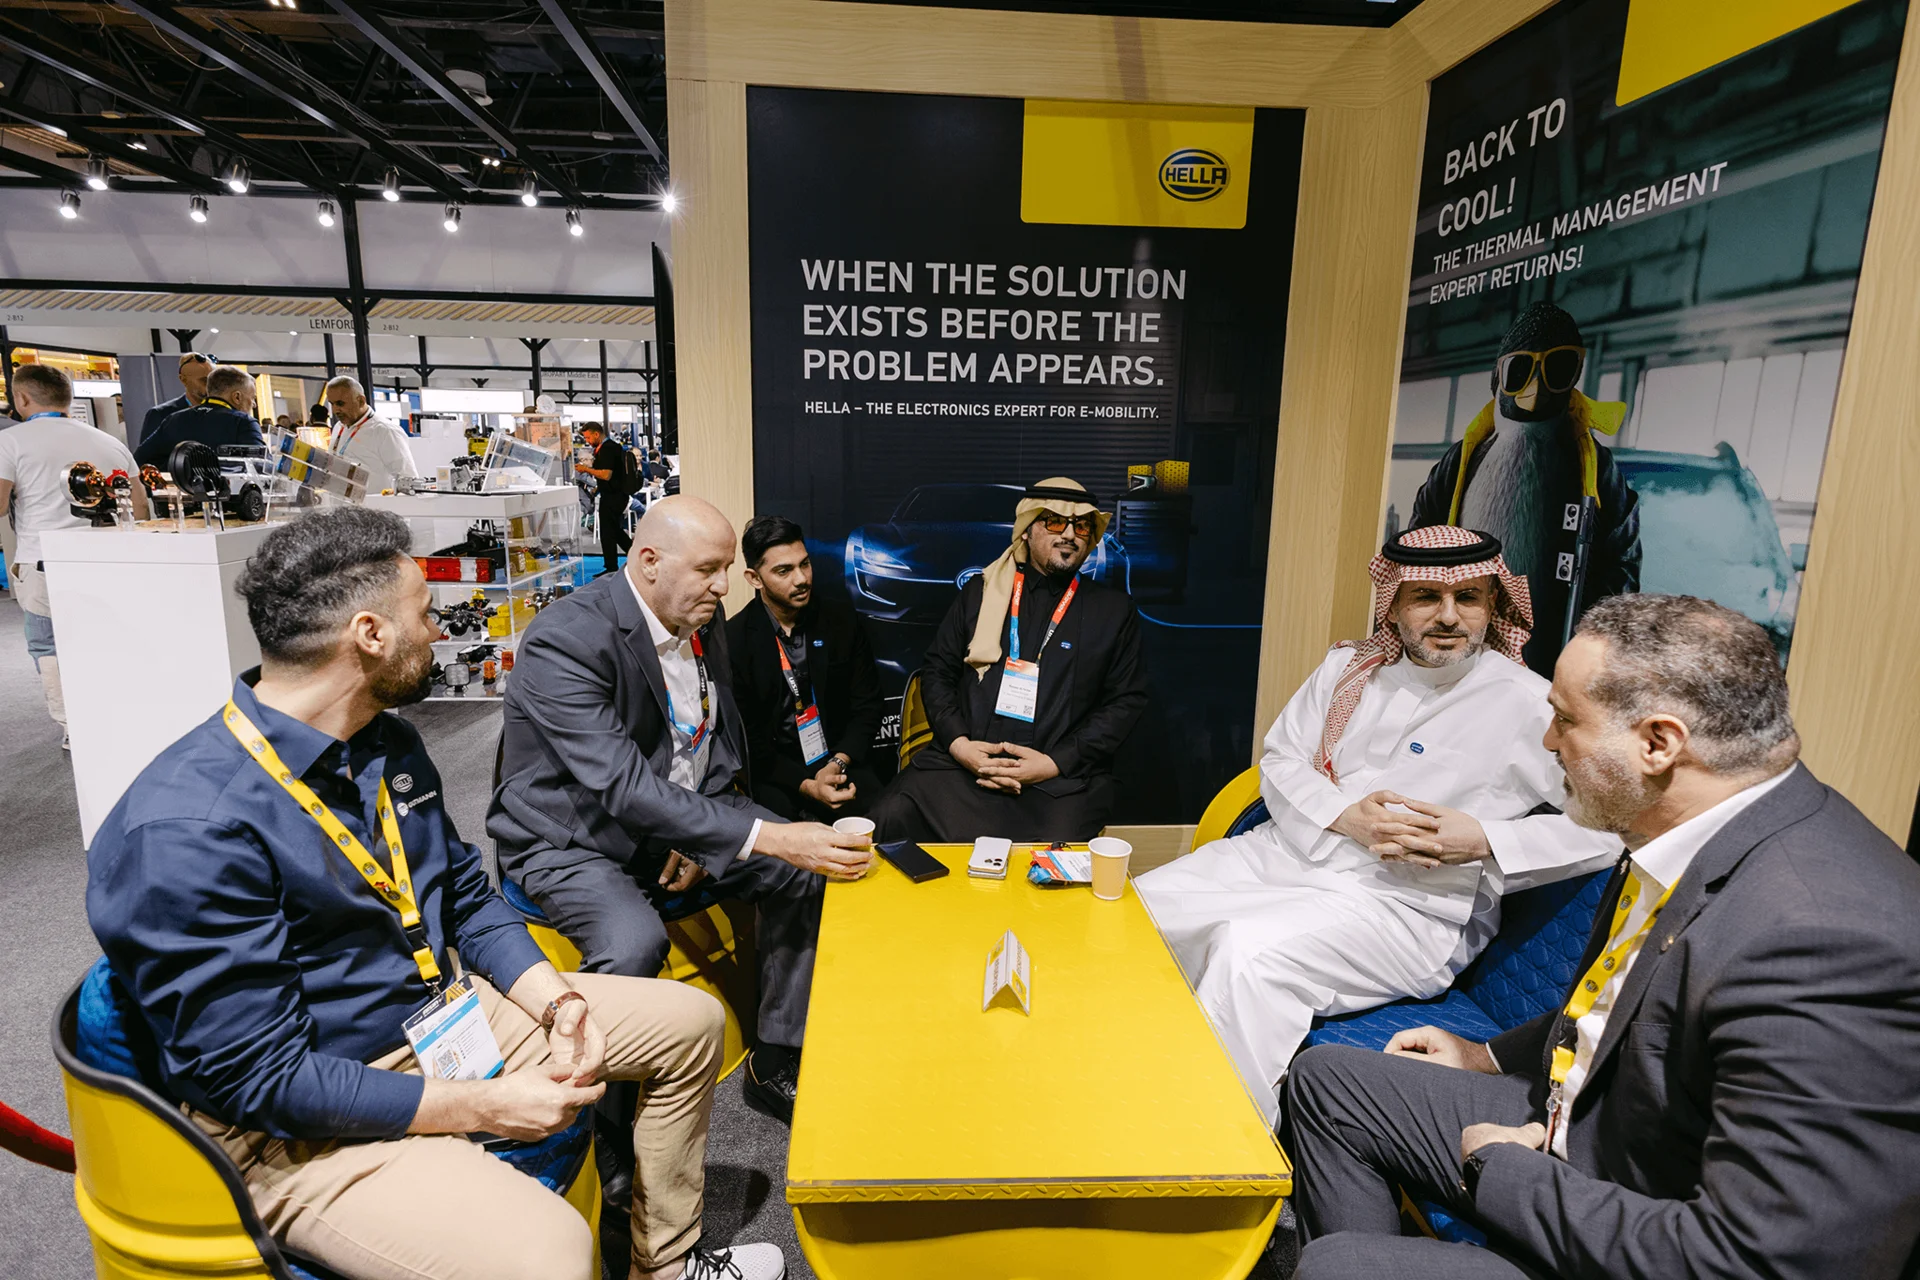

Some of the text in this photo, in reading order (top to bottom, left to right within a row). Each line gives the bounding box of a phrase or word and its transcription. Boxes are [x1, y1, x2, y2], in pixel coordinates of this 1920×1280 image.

[1443, 97, 1567, 185] BACK TO
[1165, 167, 1227, 185] HELLA
[1433, 161, 1728, 275] THE THERMAL MANAGEMENT
[1438, 177, 1516, 237] COOL!
[801, 259, 1186, 300] WHEN THE SOLUTION
[1429, 245, 1584, 305] EXPERT RETURNS!
[803, 304, 1160, 343] EXISTS BEFORE THE
[803, 349, 1164, 386] PROBLEM APPEARS.
[805, 401, 851, 414] HELLA
[866, 402, 893, 415] THE
[897, 402, 990, 417] ELECTRONICS
[994, 404, 1046, 417] EXPERT
[1050, 405, 1076, 418] FOR
[1080, 405, 1159, 419] E-MOBILITY.
